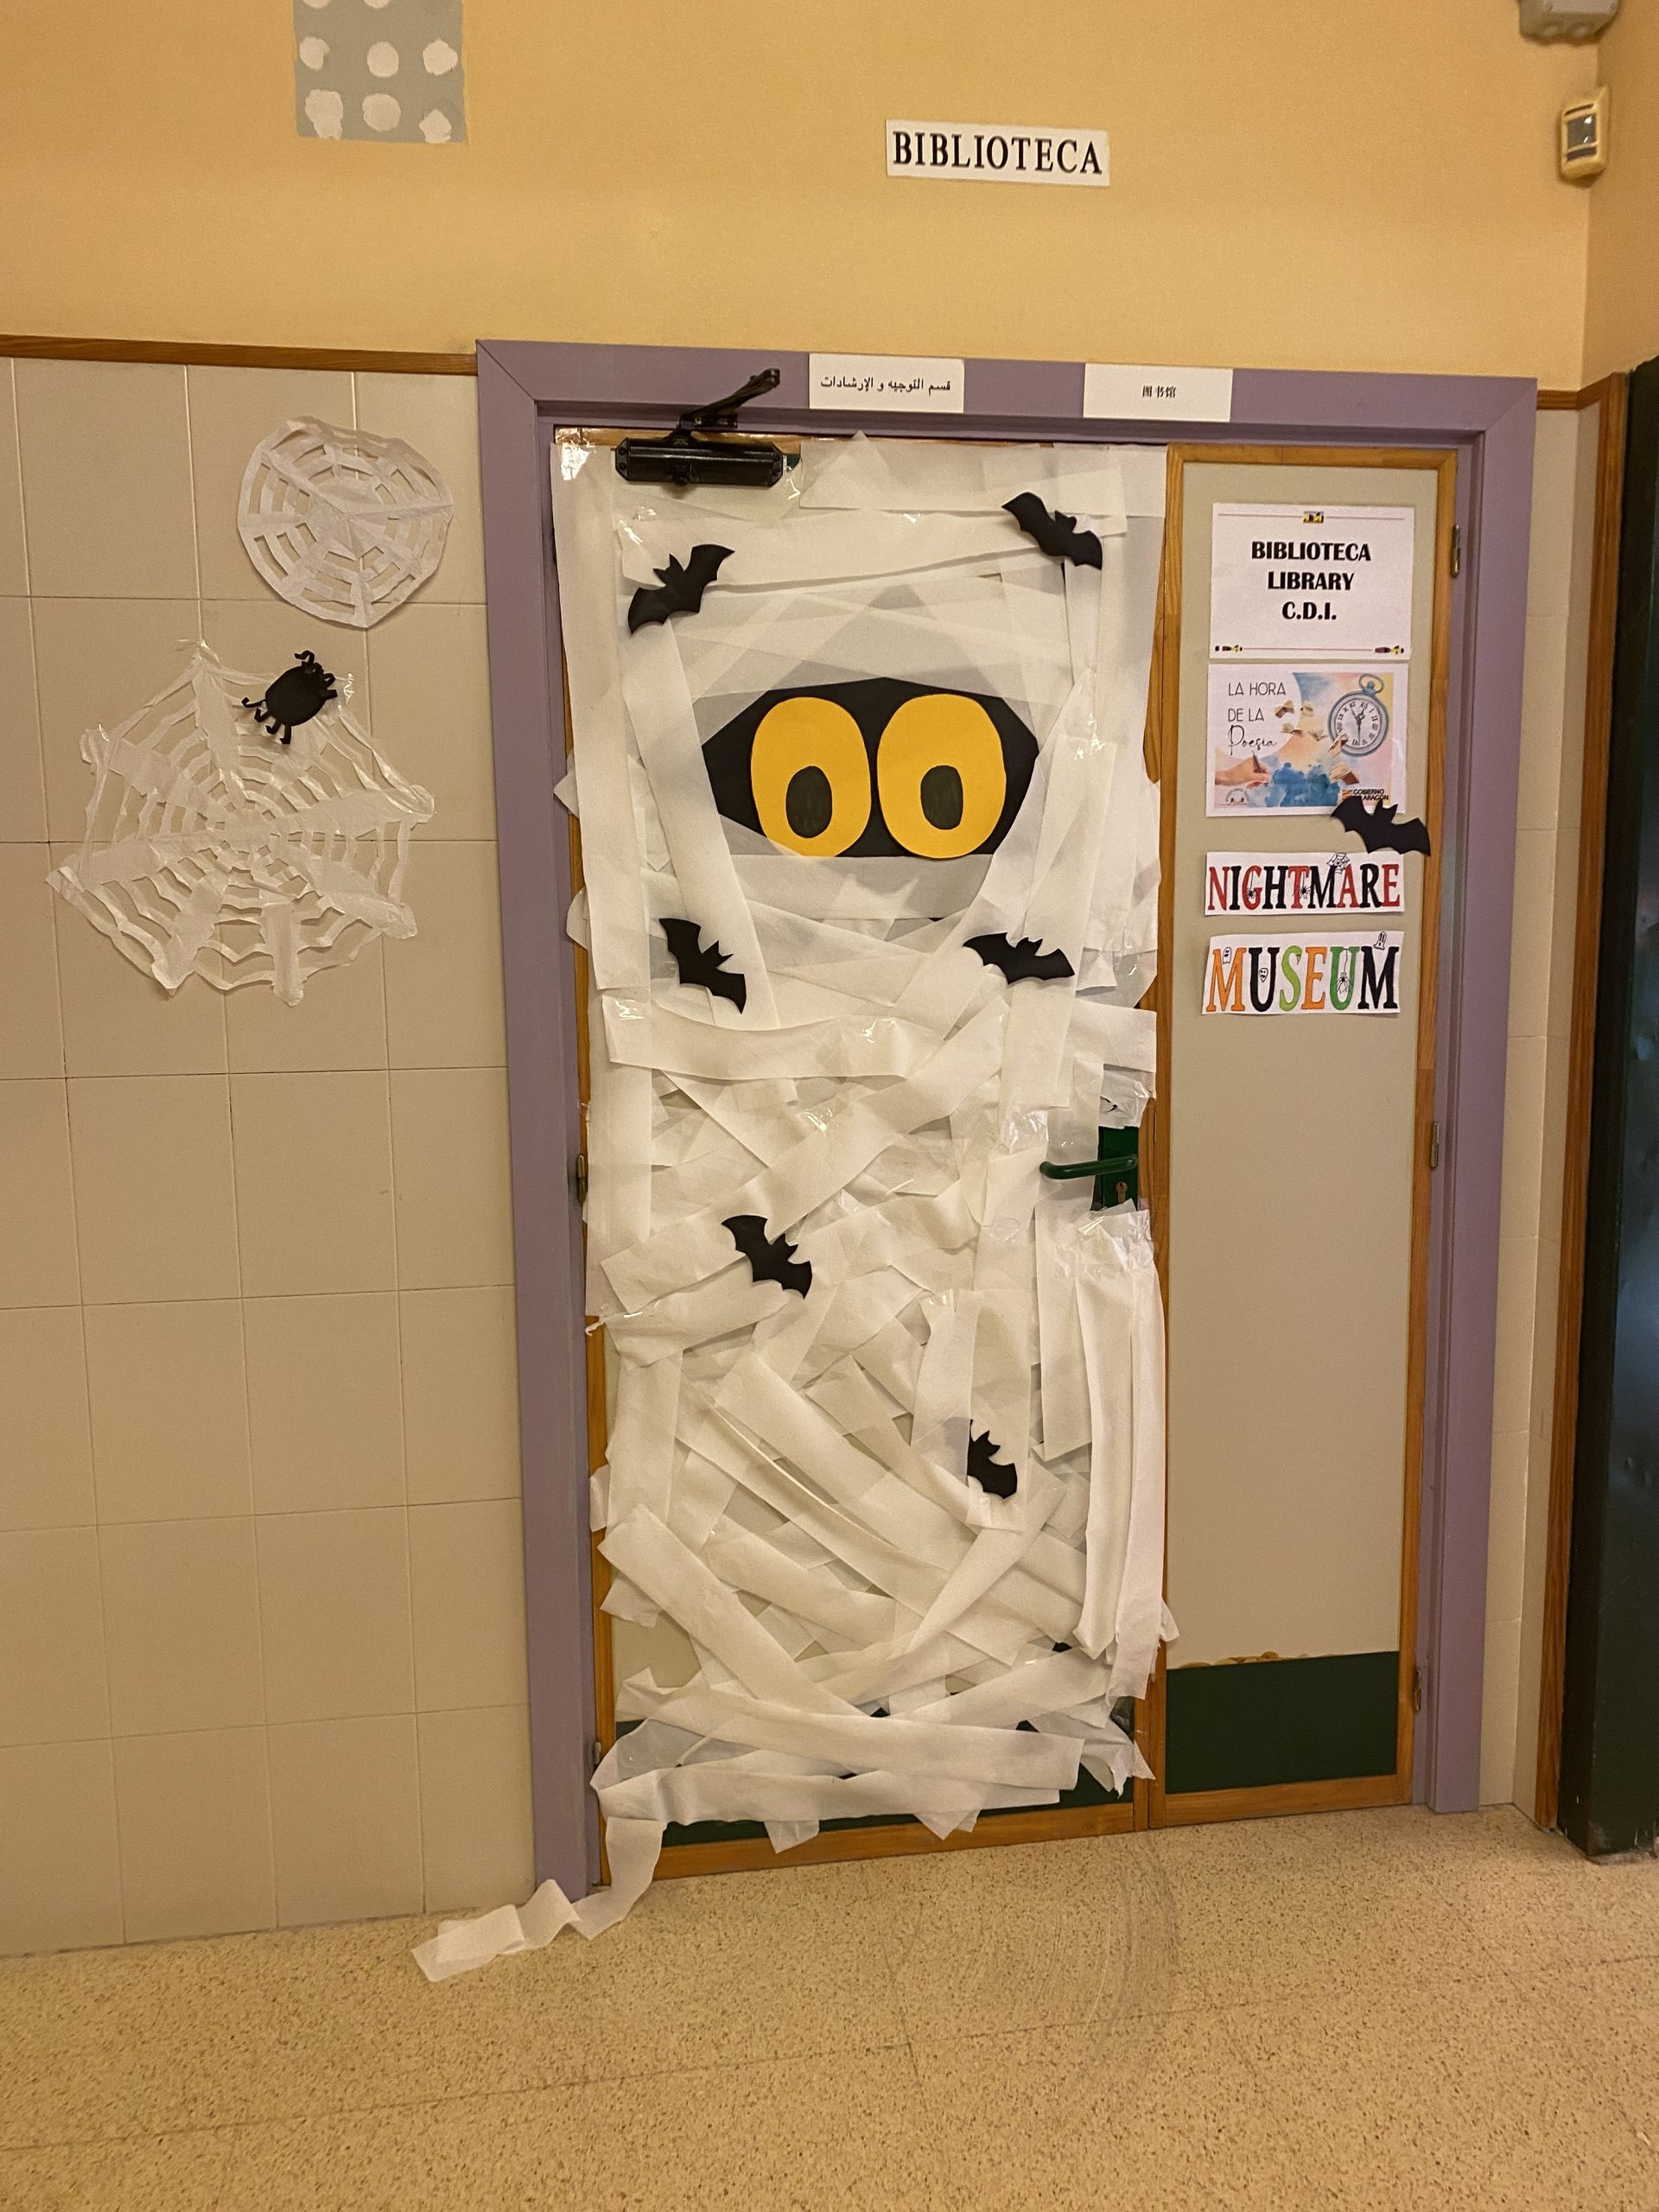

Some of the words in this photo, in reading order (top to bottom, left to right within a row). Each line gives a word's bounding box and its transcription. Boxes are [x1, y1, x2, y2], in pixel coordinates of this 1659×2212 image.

[893, 130, 1103, 175] BIBLIOTECA
[820, 376, 874, 392] الإرشادات
[887, 378, 924, 393] التوجيه
[928, 380, 951, 396] قسم
[1142, 385, 1176, 398] 图书馆
[1251, 541, 1371, 562] BIBLIOTECA
[1268, 571, 1354, 590] LIBRARY
[1281, 601, 1338, 620] C.D.I.
[1228, 682, 1244, 696] LA
[1249, 683, 1287, 696] HORA
[1228, 708, 1243, 722] DE
[1249, 709, 1265, 721] LA
[1208, 863, 1401, 911] NIGHTMARE
[1205, 945, 1400, 1013] MUSEUM
